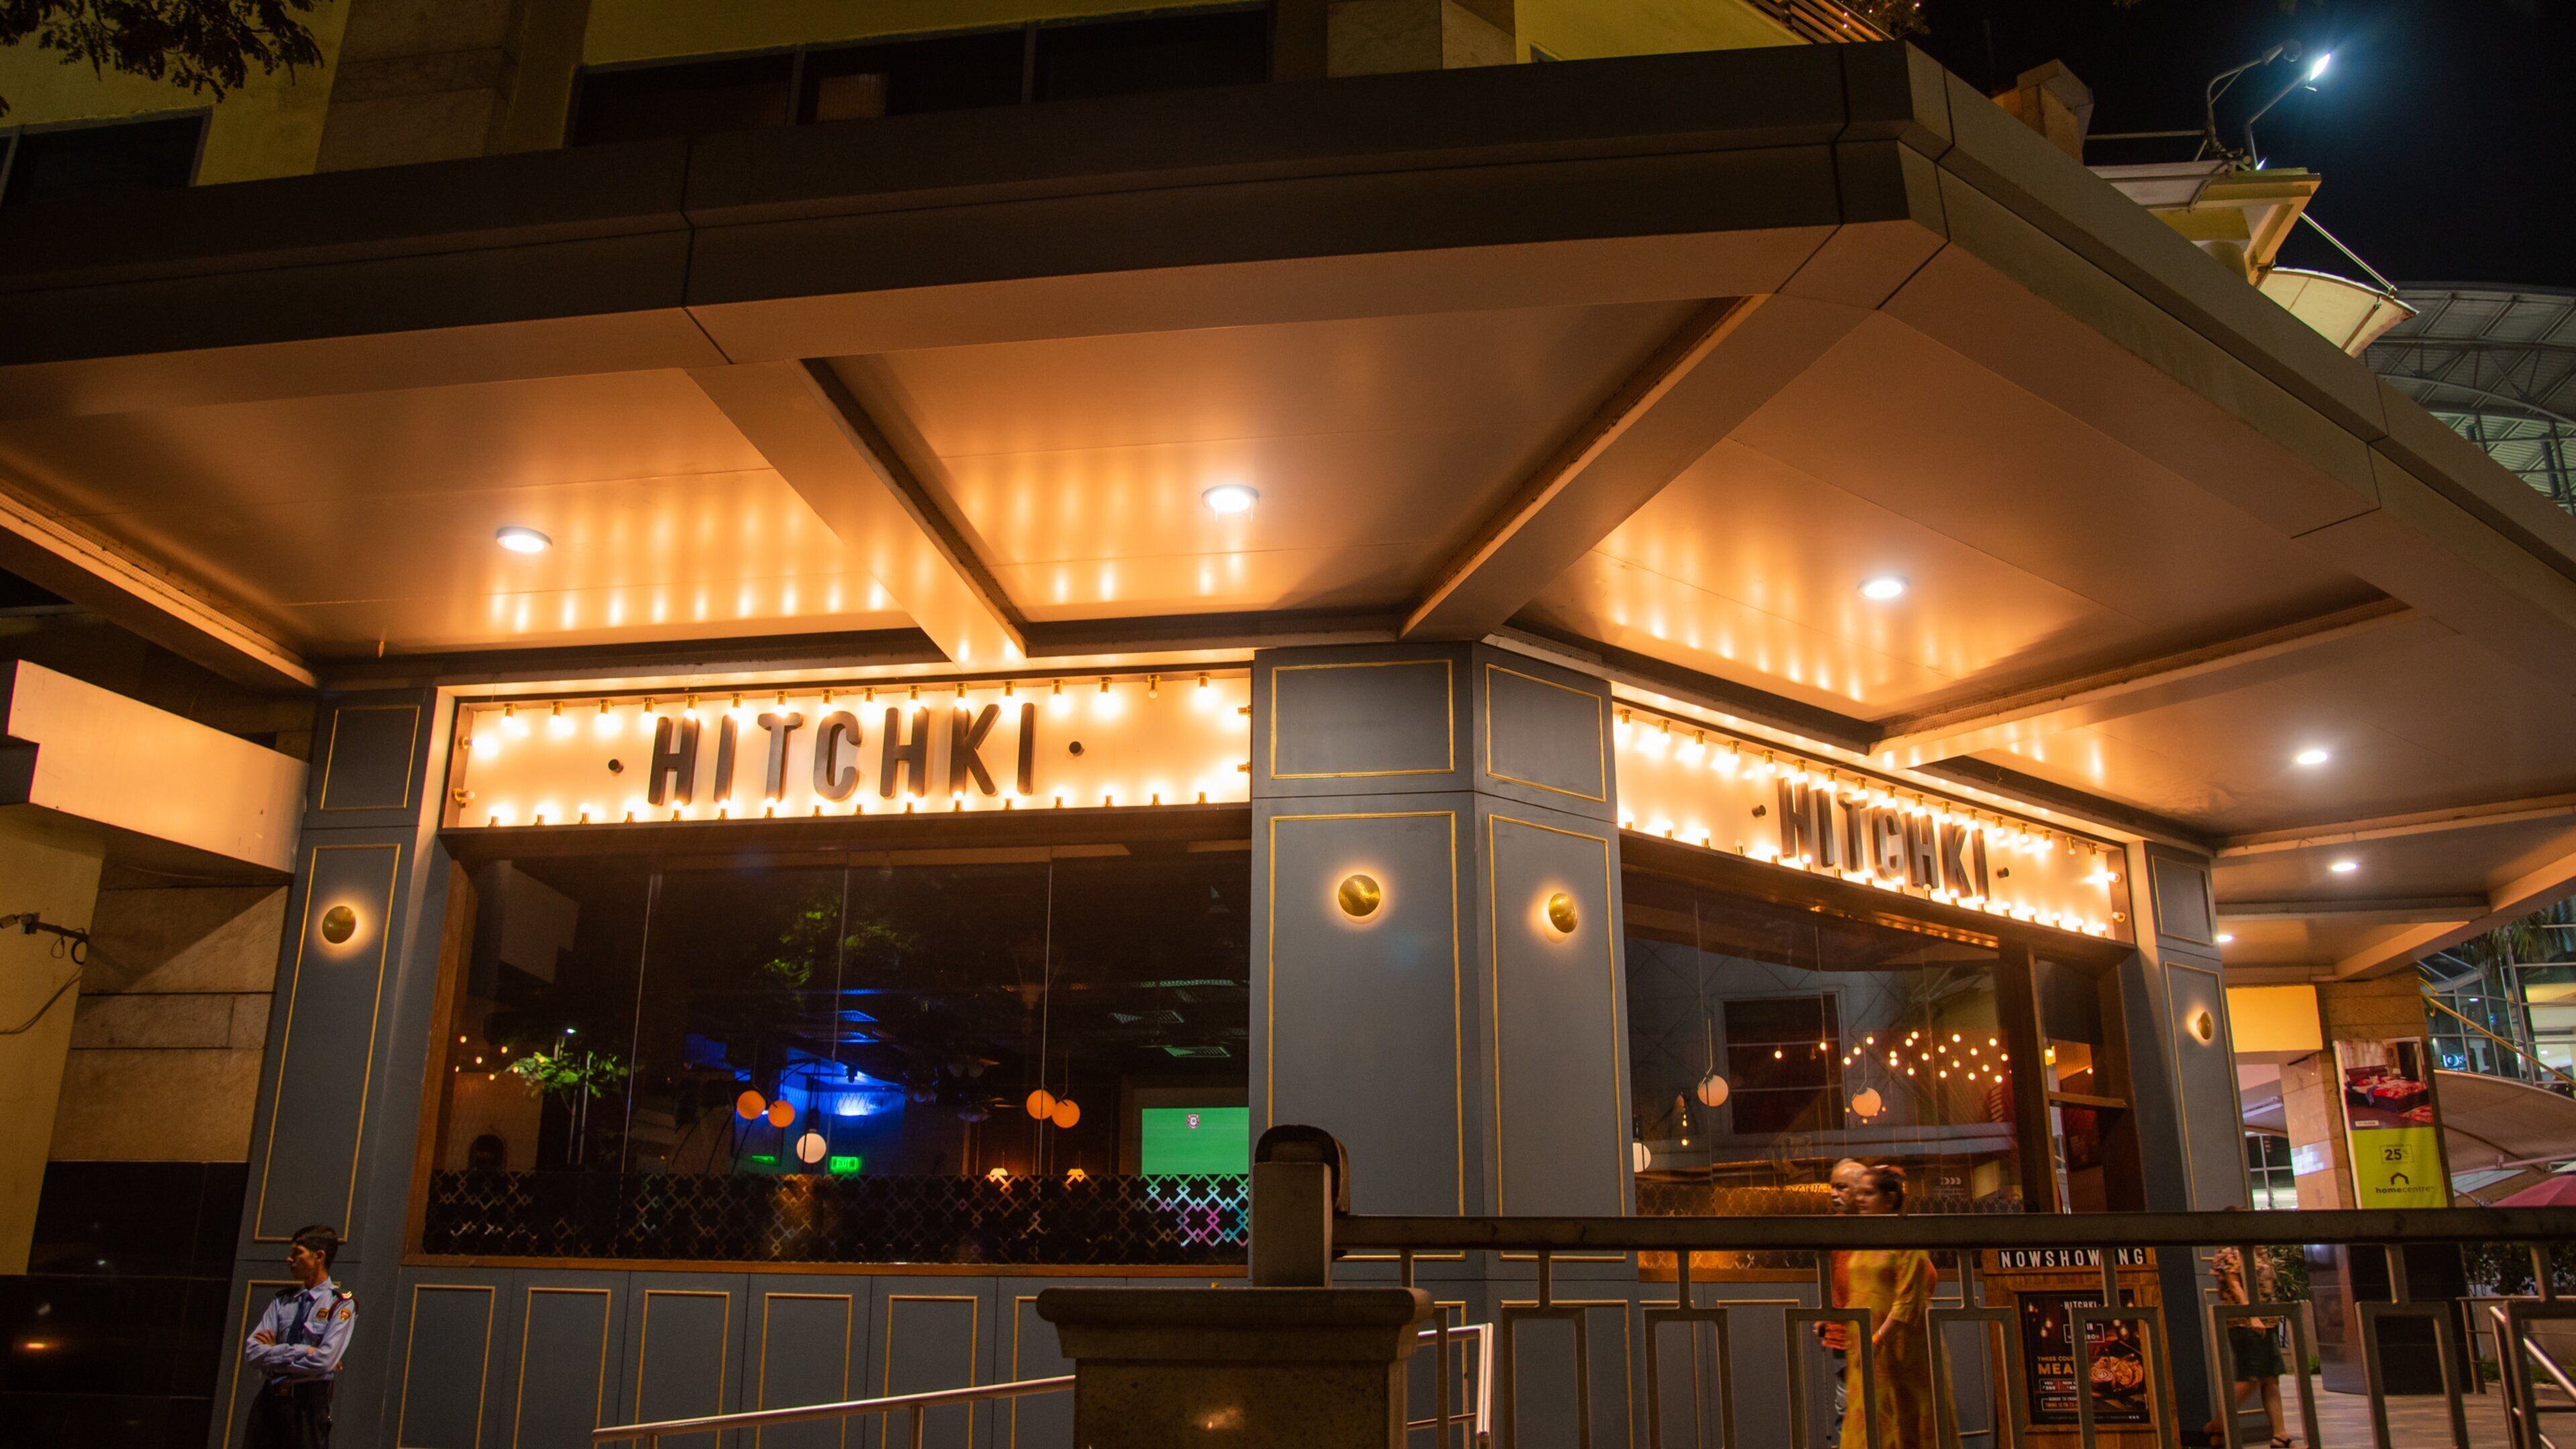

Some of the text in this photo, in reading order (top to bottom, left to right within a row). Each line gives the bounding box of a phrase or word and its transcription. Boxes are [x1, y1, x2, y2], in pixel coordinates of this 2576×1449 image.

[647, 702, 1035, 806] HITCHKI
[1778, 777, 1990, 902] HITCHKI
[2064, 1301, 2097, 1309] HITCHKI
[2038, 1362, 2074, 1375] MEA
